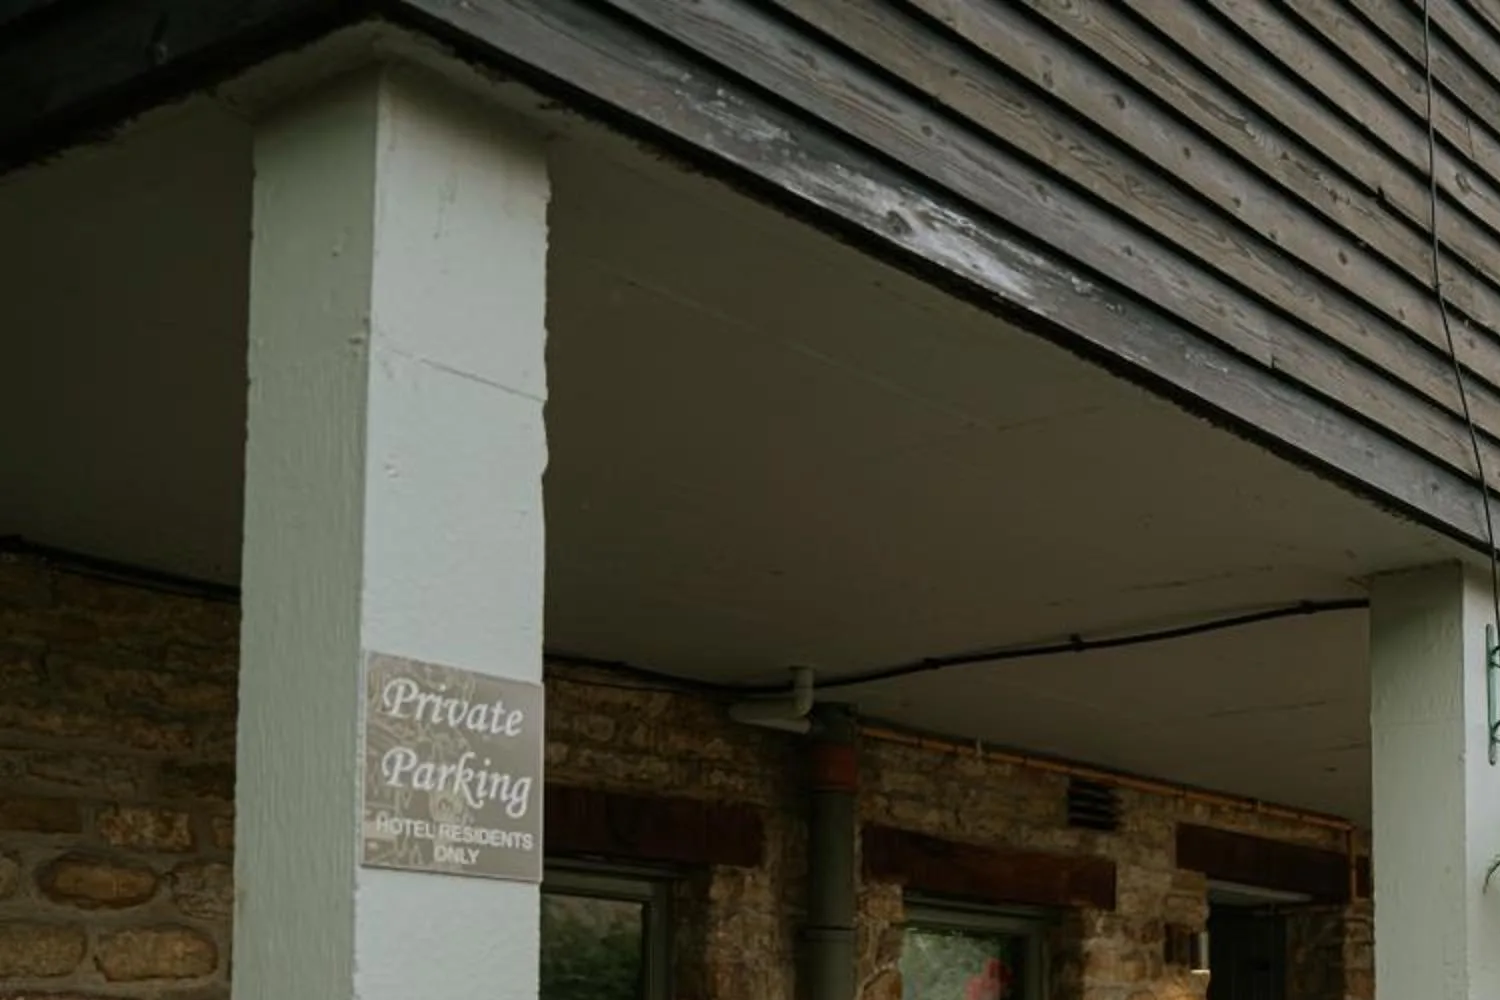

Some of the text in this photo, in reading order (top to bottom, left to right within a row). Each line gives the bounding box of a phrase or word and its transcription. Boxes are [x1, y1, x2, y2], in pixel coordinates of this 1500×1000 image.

[382, 677, 523, 737] Private
[382, 746, 532, 818] Parking
[376, 810, 534, 850] HOTEL RESIDENTS
[433, 845, 481, 865] ONLY
